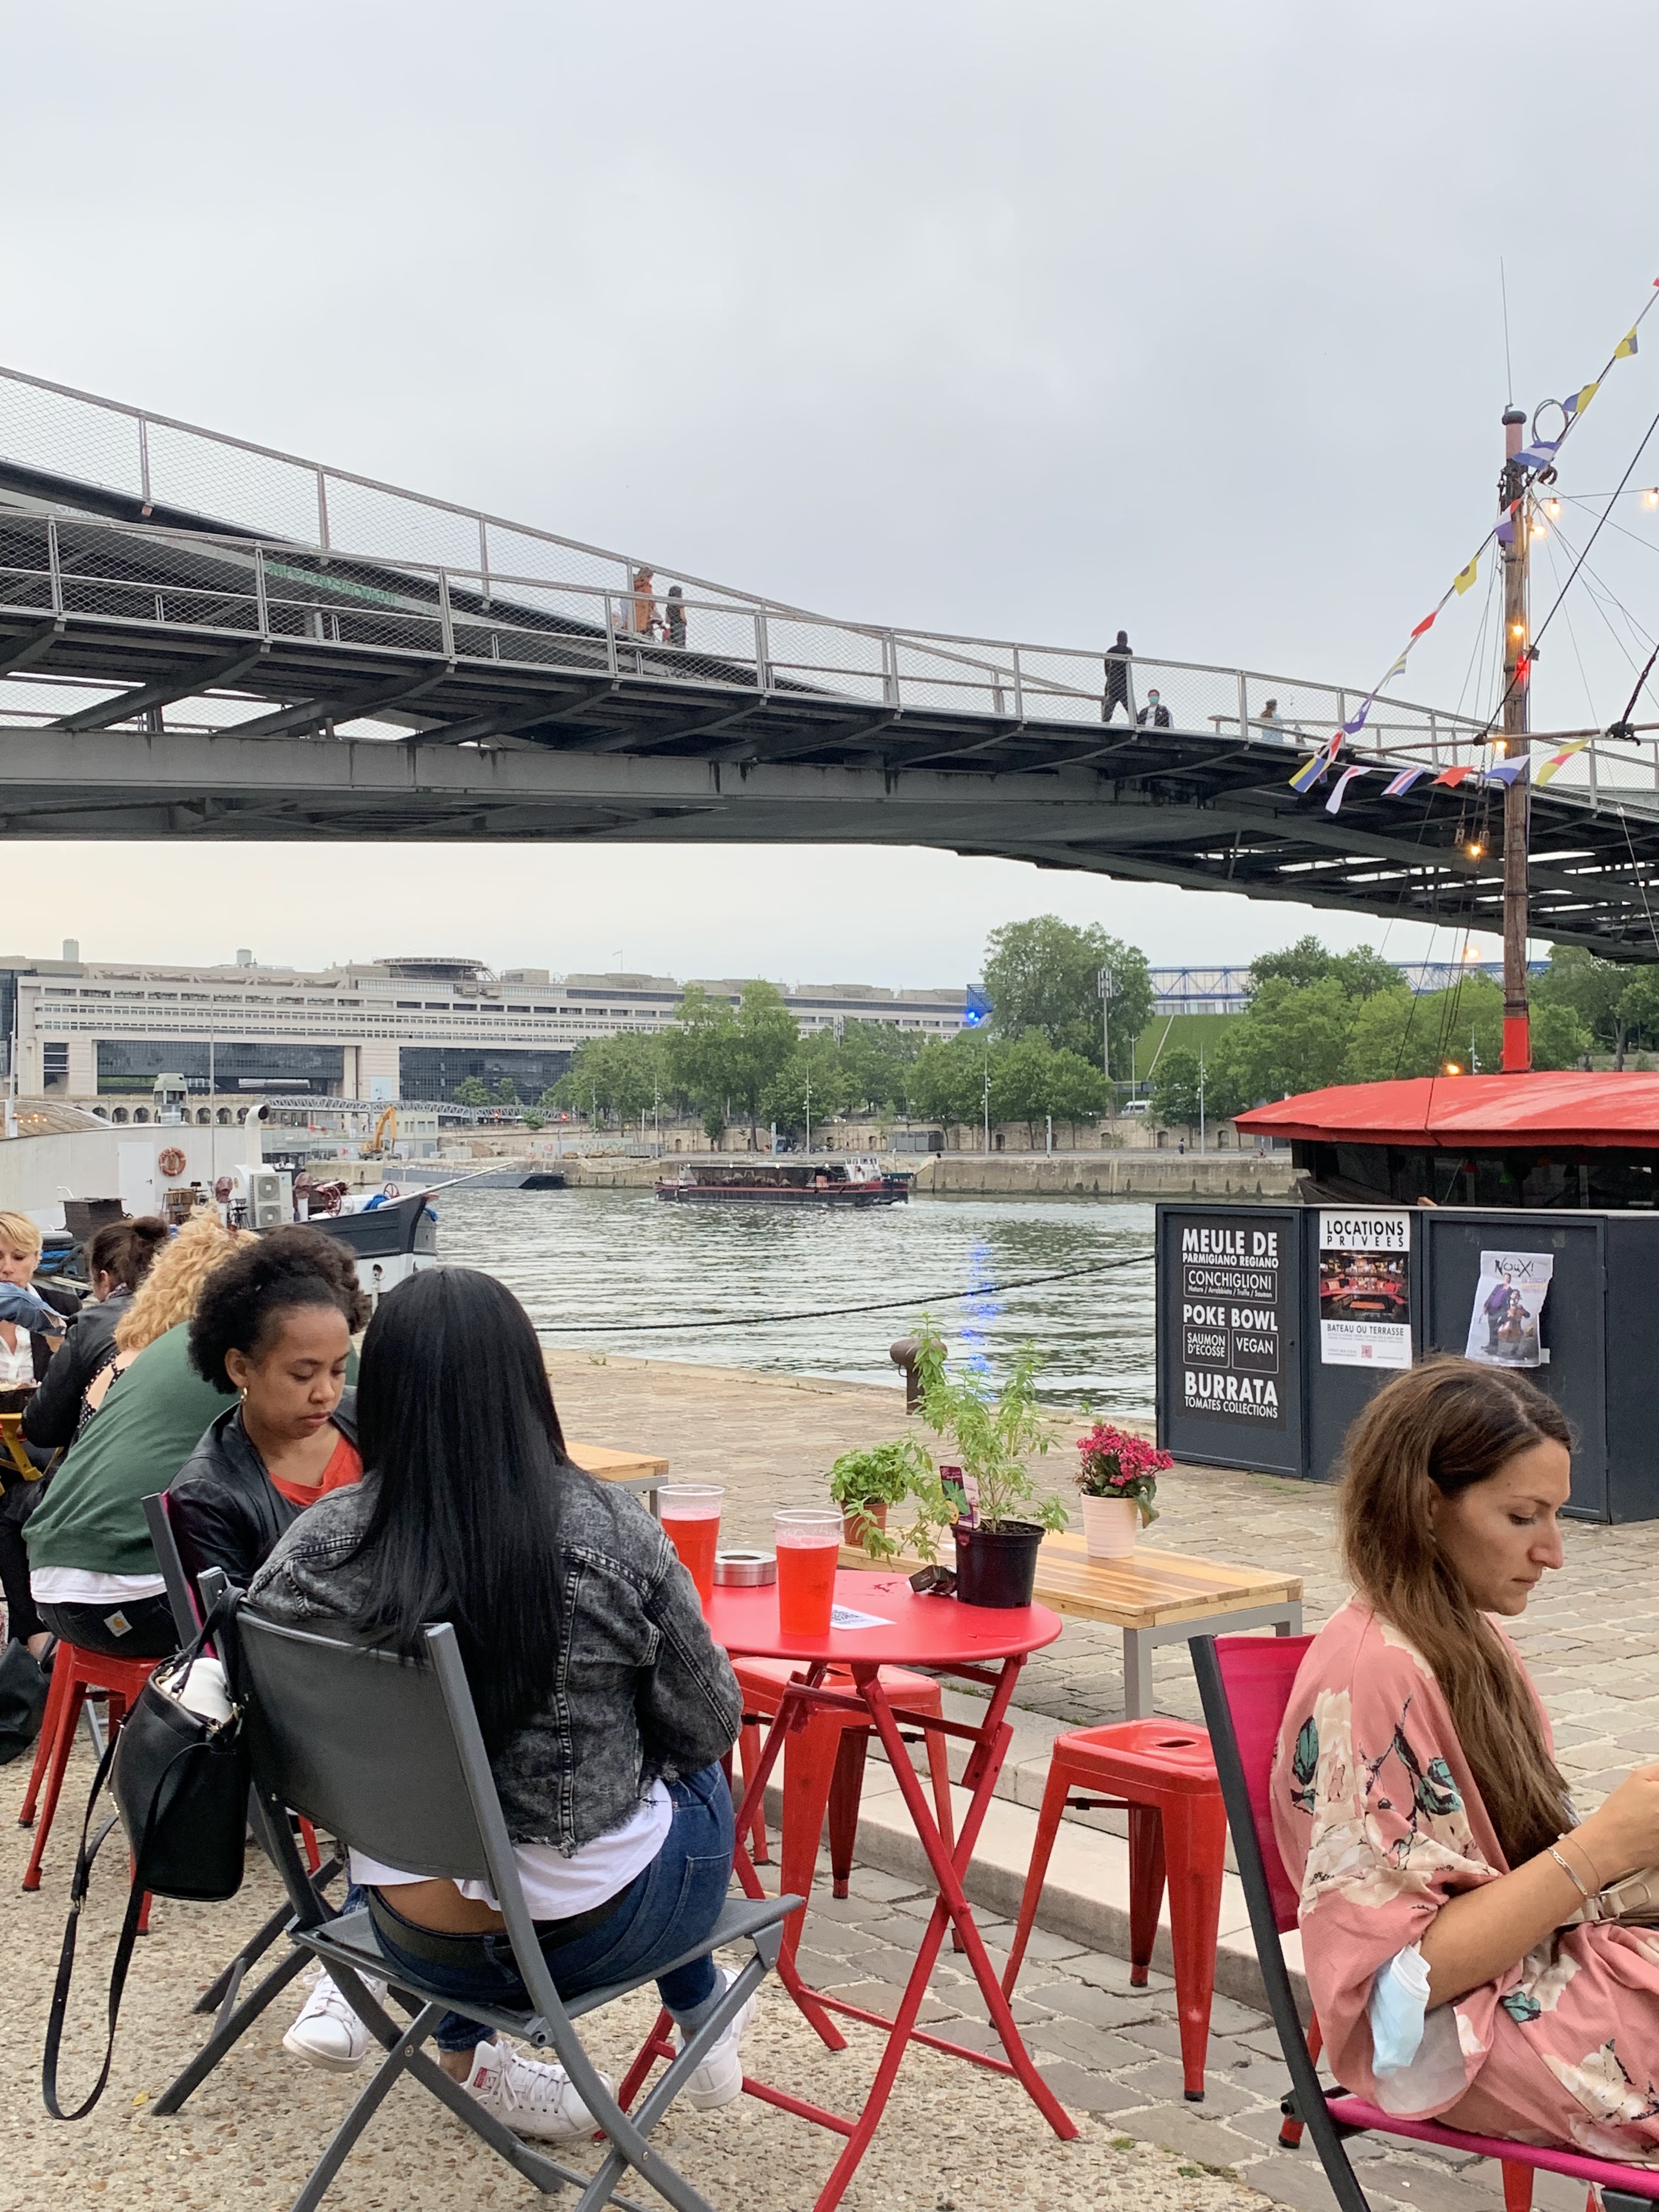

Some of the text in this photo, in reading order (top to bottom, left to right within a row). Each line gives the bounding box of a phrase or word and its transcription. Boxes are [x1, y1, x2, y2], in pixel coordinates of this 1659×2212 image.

[1327, 1220, 1403, 1235] LOCATIONS
[1182, 1228, 1277, 1256] MEULE DE
[1327, 1235, 1403, 1247] PRIVEES
[1182, 1252, 1279, 1268] PARMIGIANO REGIANO
[1188, 1269, 1271, 1290] CONCHIGLIONI
[1183, 1304, 1278, 1331] POKE BOWL
[1327, 1324, 1404, 1336] BATEAU OU TERRASSE
[1187, 1332, 1226, 1346] SAUMON
[1235, 1336, 1273, 1355] VEGAN
[1188, 1345, 1225, 1357] D'ECOSSE
[1185, 1371, 1278, 1406] BURRATA
[1184, 1396, 1278, 1418] TOMATES COLLECTIONS
